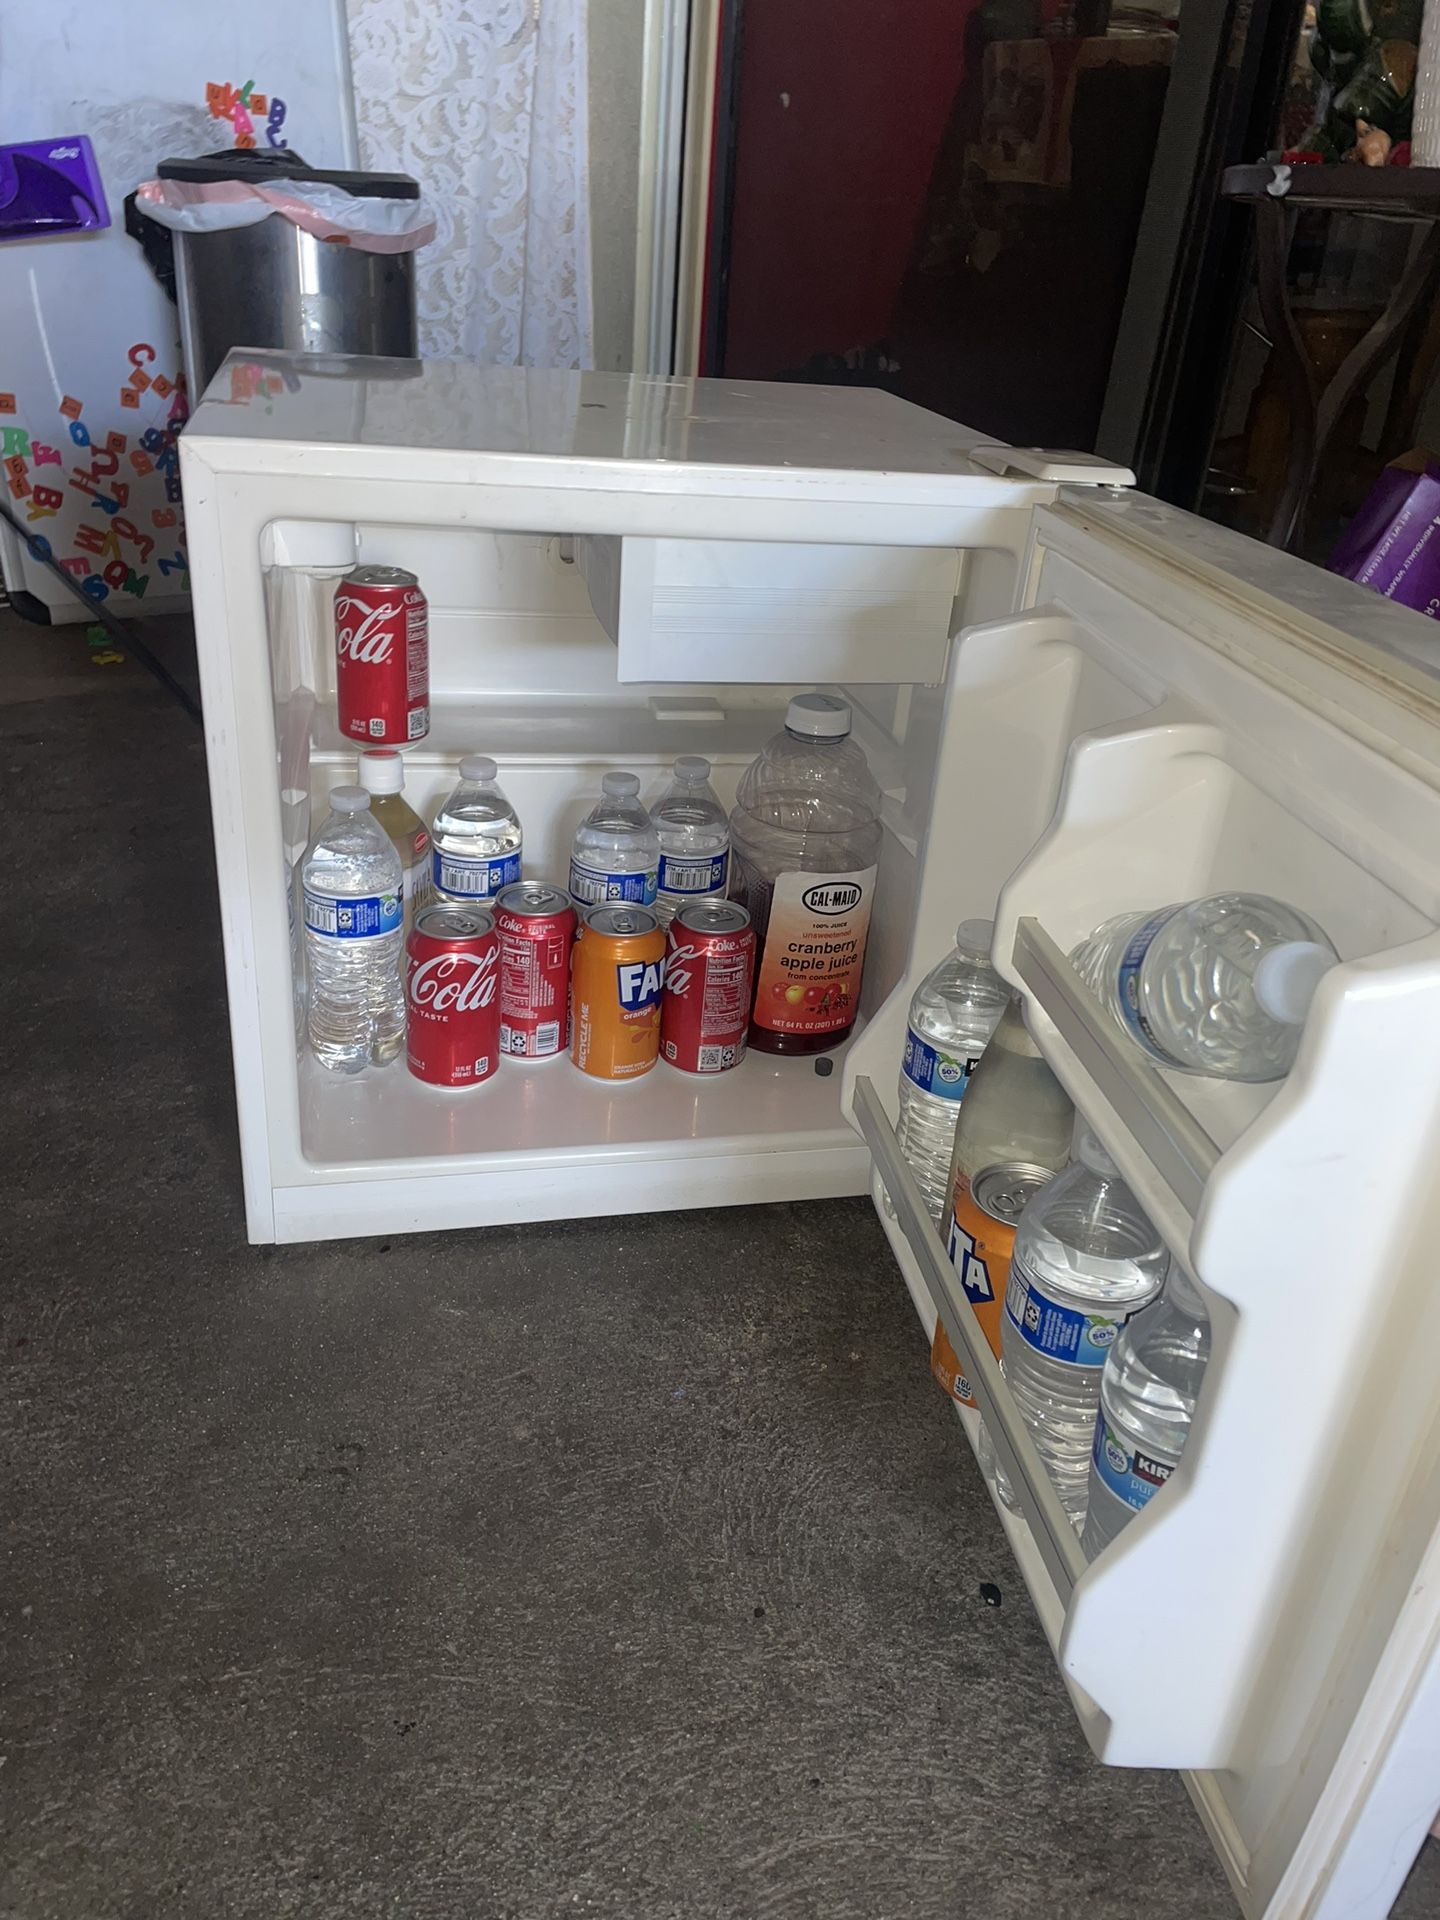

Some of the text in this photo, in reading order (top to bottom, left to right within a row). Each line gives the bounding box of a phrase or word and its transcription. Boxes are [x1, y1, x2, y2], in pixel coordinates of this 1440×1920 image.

[810, 888, 858, 907] CAL-MAID
[498, 914, 523, 933] Coke
[708, 938, 736, 952] Coke
[788, 938, 858, 955] cranberry
[516, 955, 530, 966] 140
[780, 953, 858, 973] apple juice
[411, 945, 499, 1012] Cola
[787, 971, 807, 980] from
[419, 1010, 449, 1023] TASTE
[623, 1007, 652, 1021] orange
[772, 1018, 785, 1027] NET
[795, 1021, 804, 1029] FL
[578, 1002, 589, 1070] RECYCLE ME
[953, 1218, 990, 1296] TA
[1138, 1457, 1173, 1480] KIR
